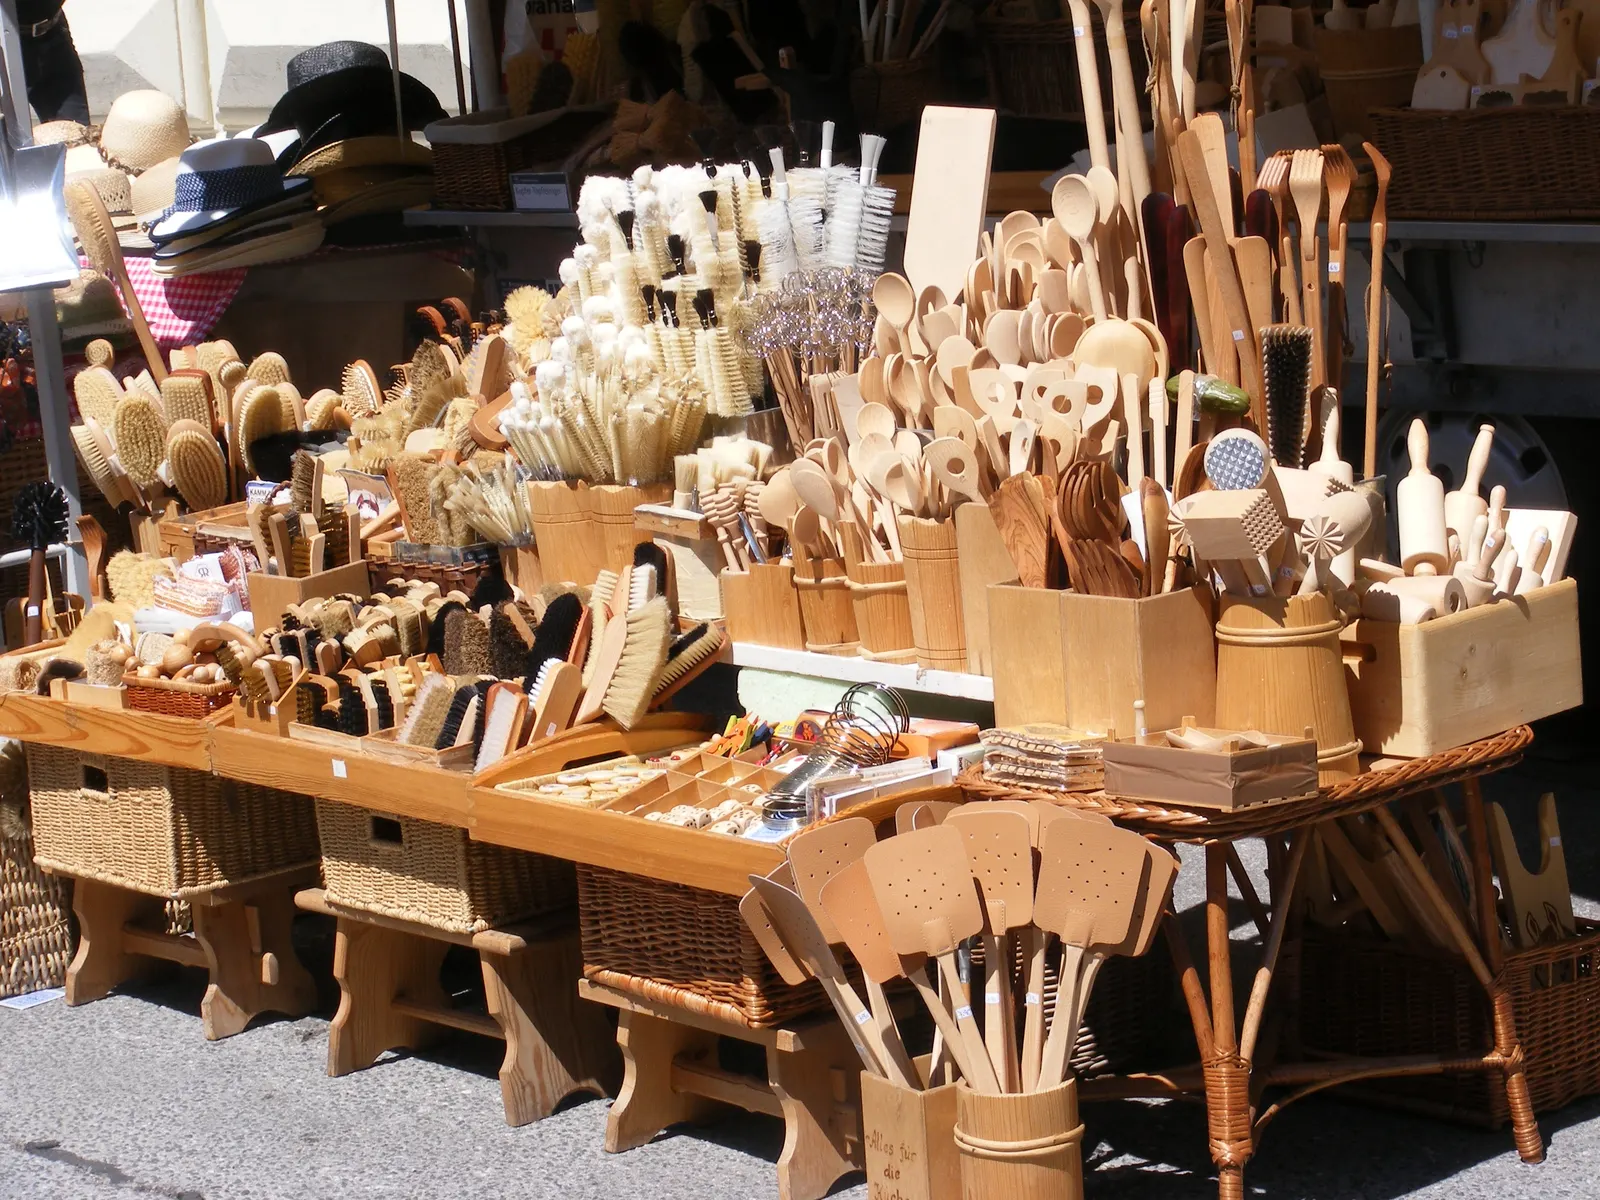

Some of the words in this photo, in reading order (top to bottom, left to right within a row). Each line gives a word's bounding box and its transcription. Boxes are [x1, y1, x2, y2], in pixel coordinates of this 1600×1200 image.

[865, 1129, 894, 1156] Alles
[883, 1163, 901, 1180] die
[873, 1181, 910, 1200] Küch
